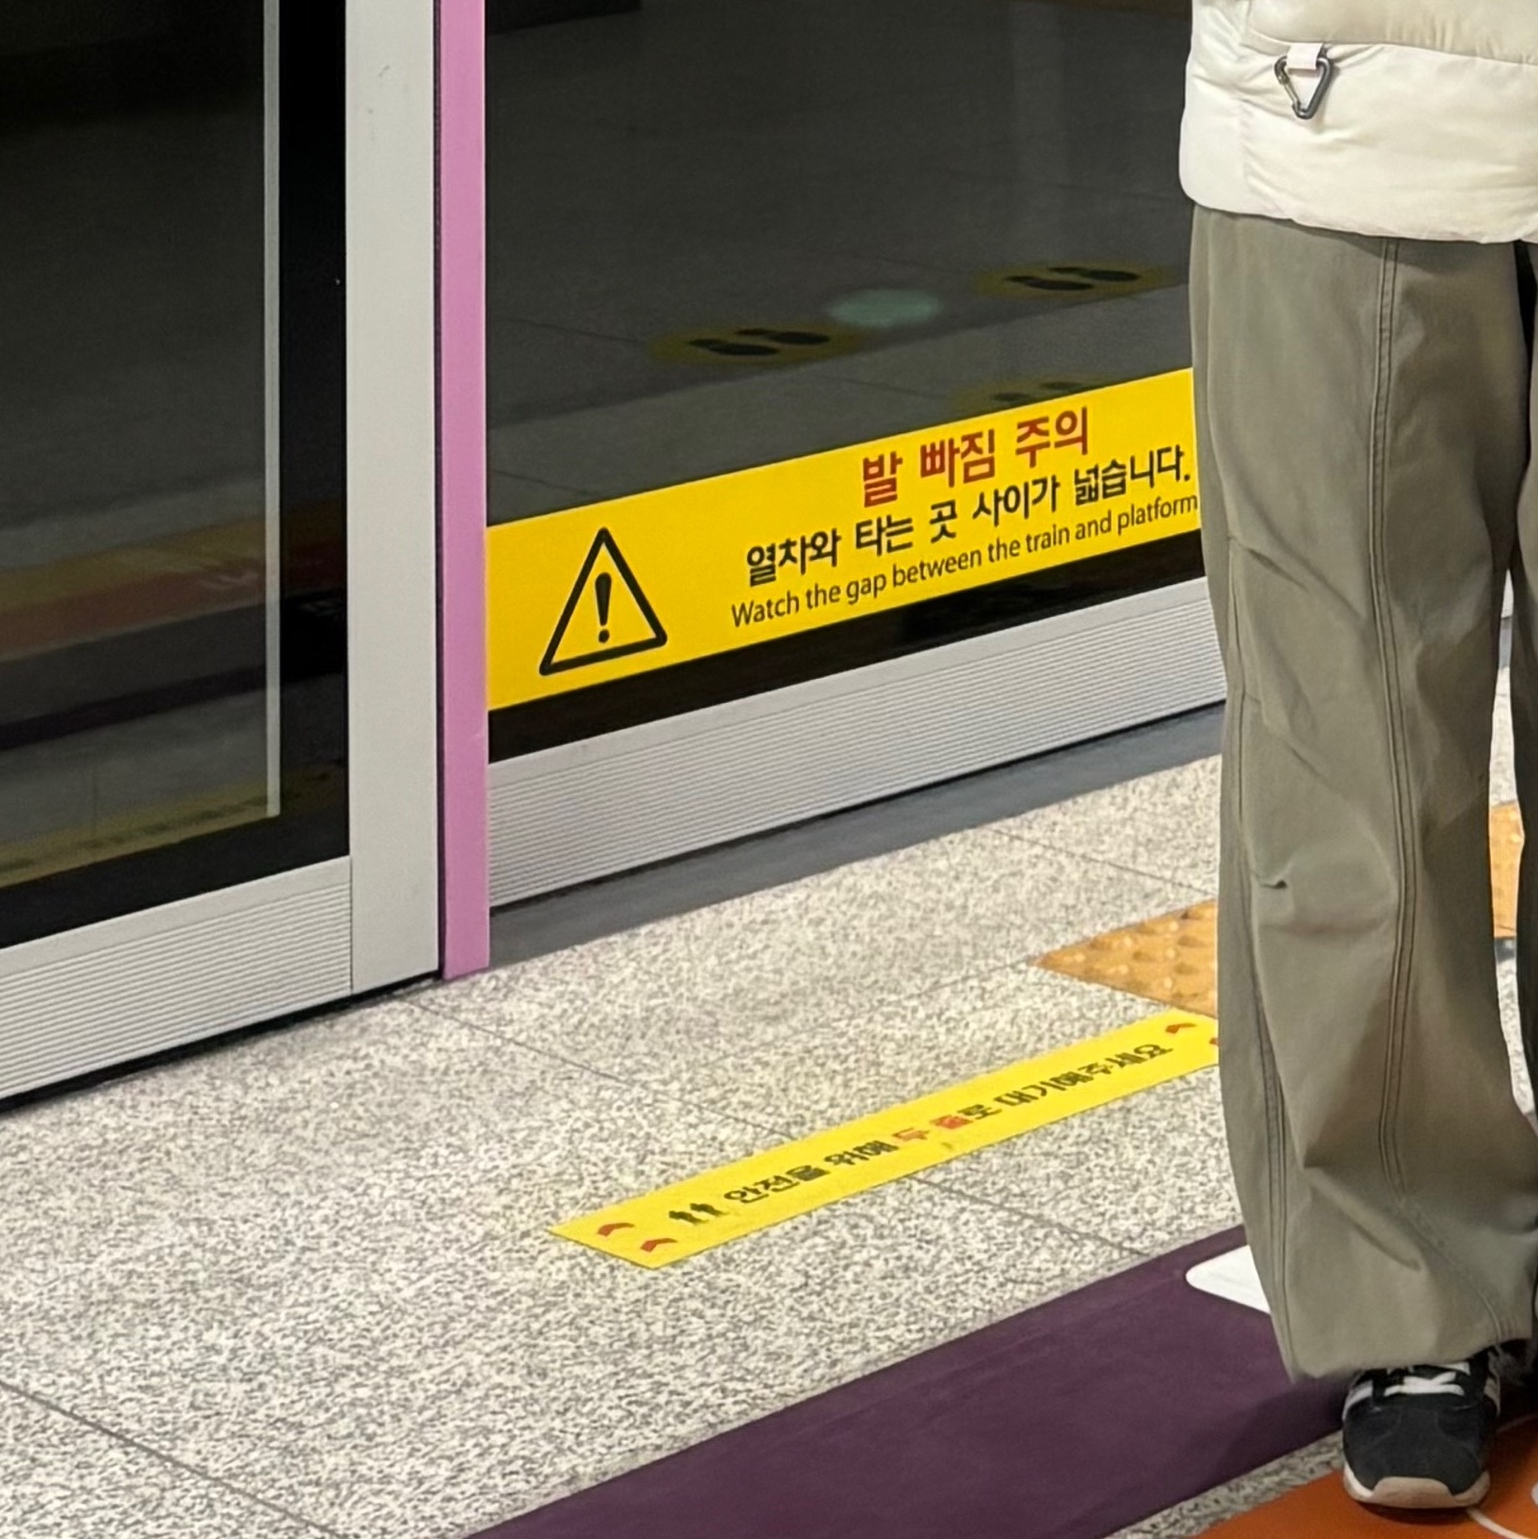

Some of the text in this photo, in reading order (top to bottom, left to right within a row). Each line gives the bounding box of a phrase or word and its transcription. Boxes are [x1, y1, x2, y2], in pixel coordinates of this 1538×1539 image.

[746, 443, 1191, 588] 열차와 타는 곳 사이가 넓습니다.
[862, 405, 1089, 508] 발 빠짐 주의
[731, 494, 1198, 628] Watch the gap between the train and platform
[723, 1164, 830, 1204] 안전을
[823, 1140, 900, 1166] 위해
[993, 1043, 1174, 1107] 대기해주세요
